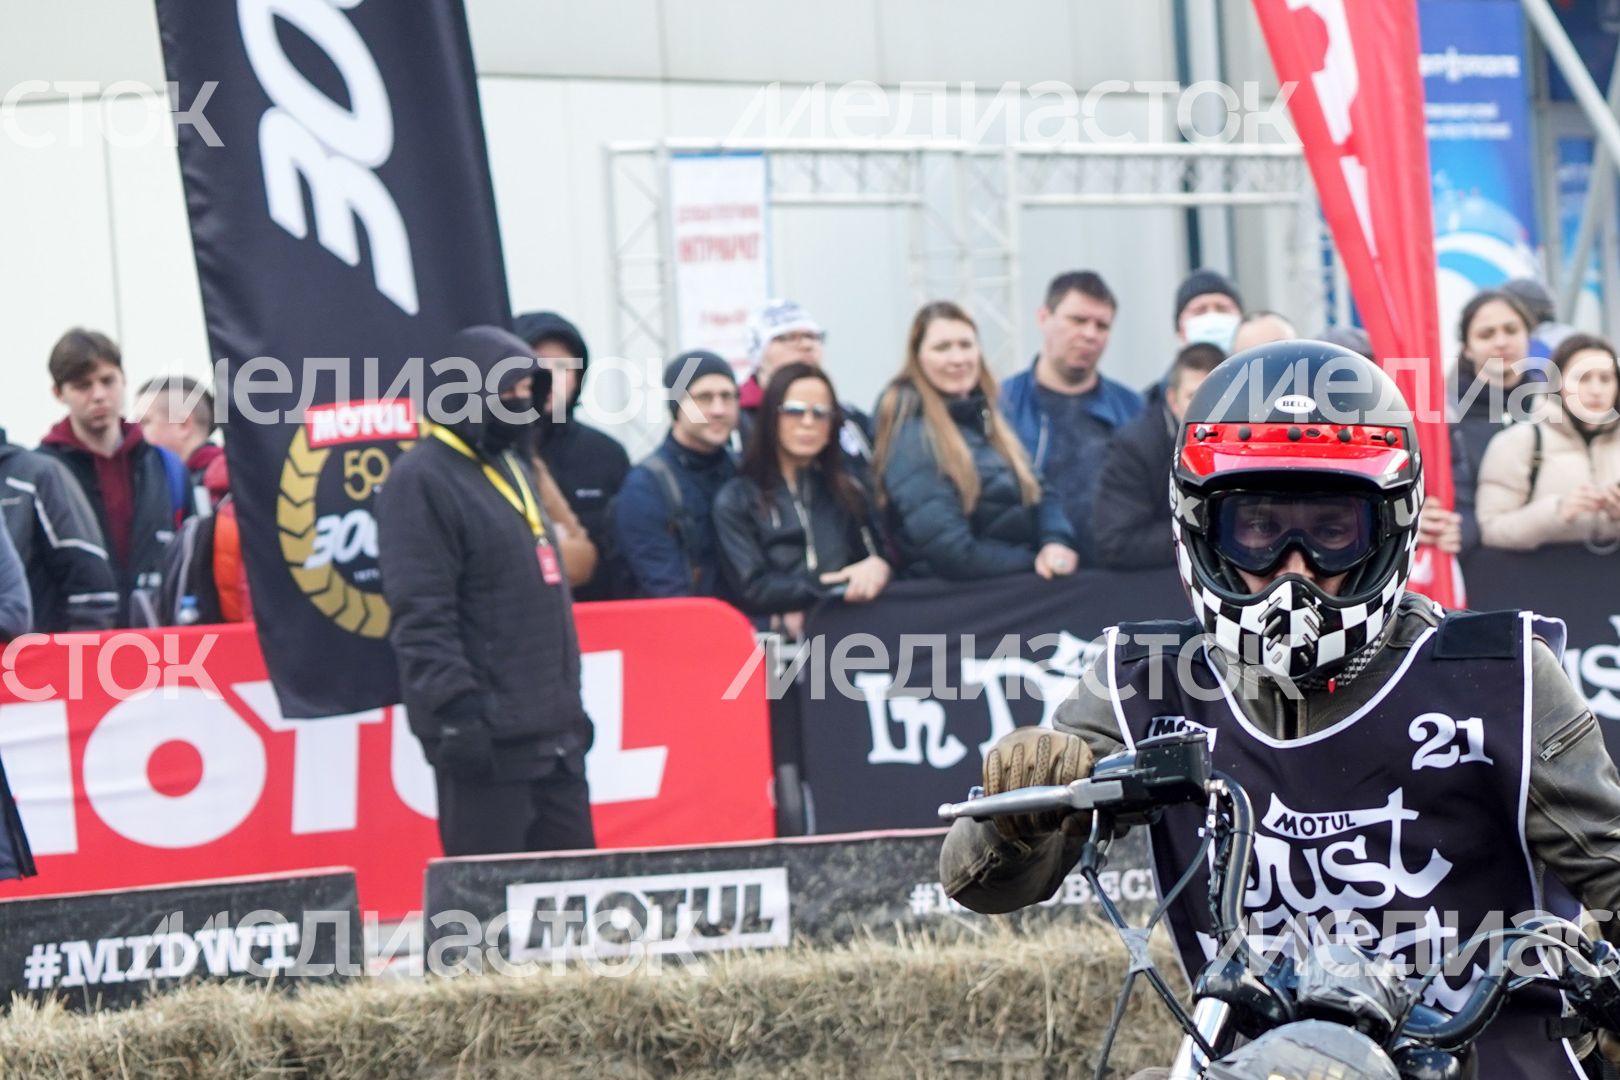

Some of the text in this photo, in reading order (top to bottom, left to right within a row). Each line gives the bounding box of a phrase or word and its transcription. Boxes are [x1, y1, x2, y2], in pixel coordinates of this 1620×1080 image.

[236, 0, 420, 316] 30
[312, 402, 413, 442] MOTUL
[1281, 399, 1309, 409] BELL
[343, 447, 390, 501] 50
[853, 672, 968, 769] In
[1408, 711, 1494, 771] 21
[1273, 812, 1357, 837] MOTUL
[525, 882, 775, 949] MOTUL
[24, 921, 300, 991] #MIDWT
